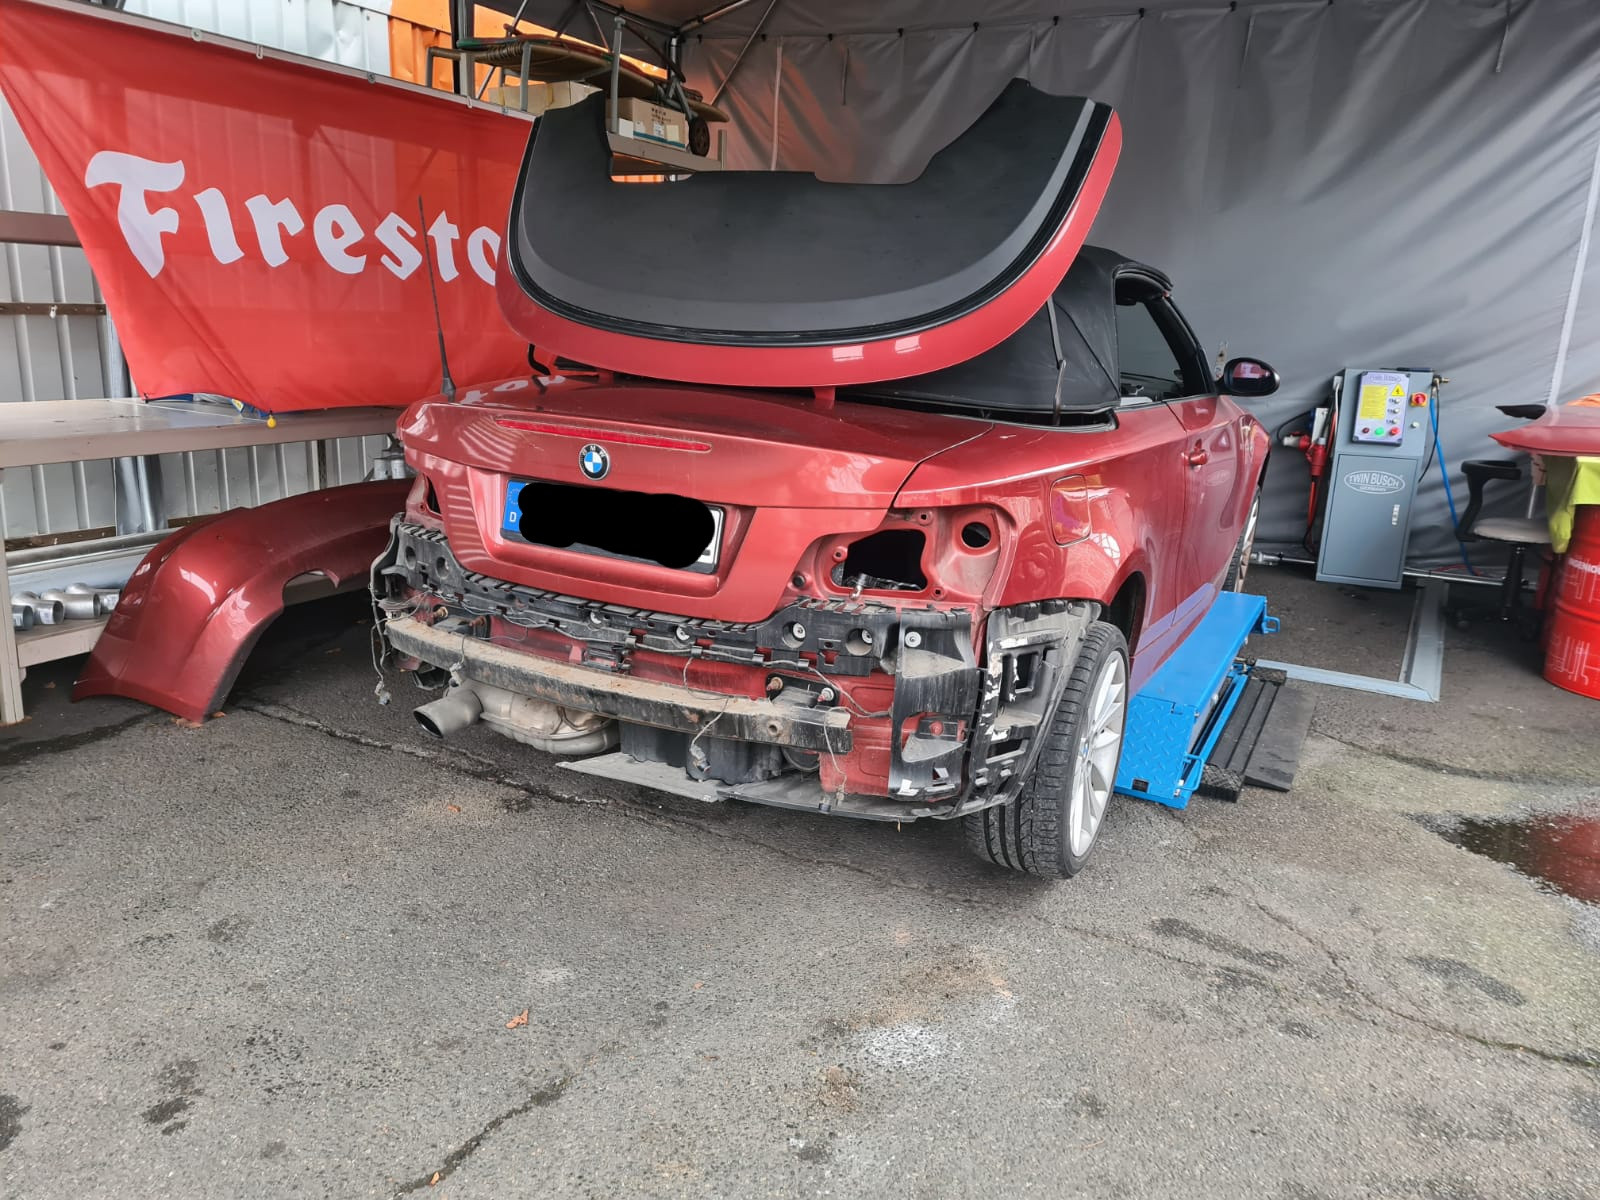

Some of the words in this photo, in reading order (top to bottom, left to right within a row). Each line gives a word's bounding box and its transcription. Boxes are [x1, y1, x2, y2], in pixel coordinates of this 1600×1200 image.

[1350, 473, 1370, 485] TWIN
[1370, 473, 1400, 487] BUSCH
[509, 511, 517, 523] D
